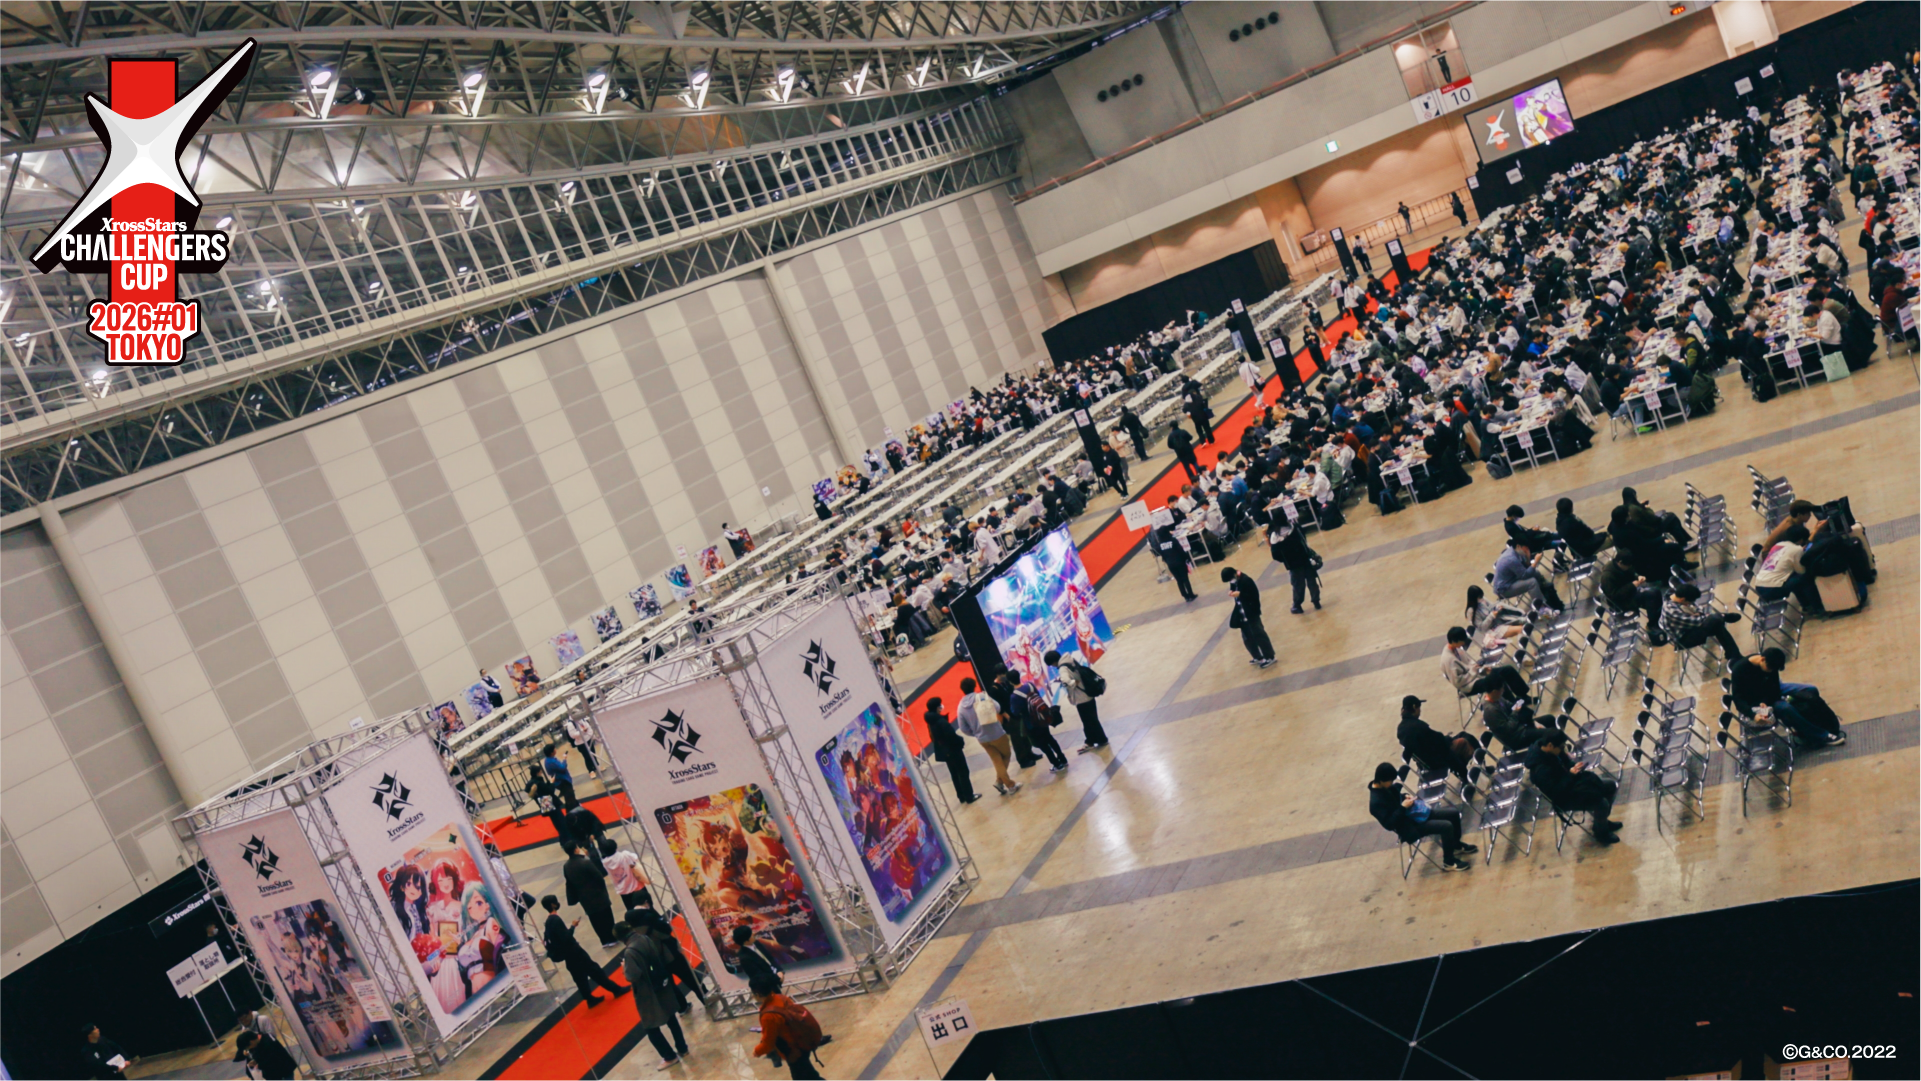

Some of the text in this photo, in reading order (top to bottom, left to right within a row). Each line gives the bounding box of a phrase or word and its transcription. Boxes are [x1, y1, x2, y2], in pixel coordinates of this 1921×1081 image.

[1451, 87, 1471, 105] 10
[1160, 541, 1172, 550] STAFF
[819, 687, 850, 715] XrossStars
[668, 762, 716, 780] XrossStars
[387, 811, 424, 838] XrossStars
[257, 879, 293, 894] XrossStars
[172, 898, 204, 921] XrossStars
[942, 1007, 961, 1017] SHOP
[931, 1016, 968, 1041] 出口
